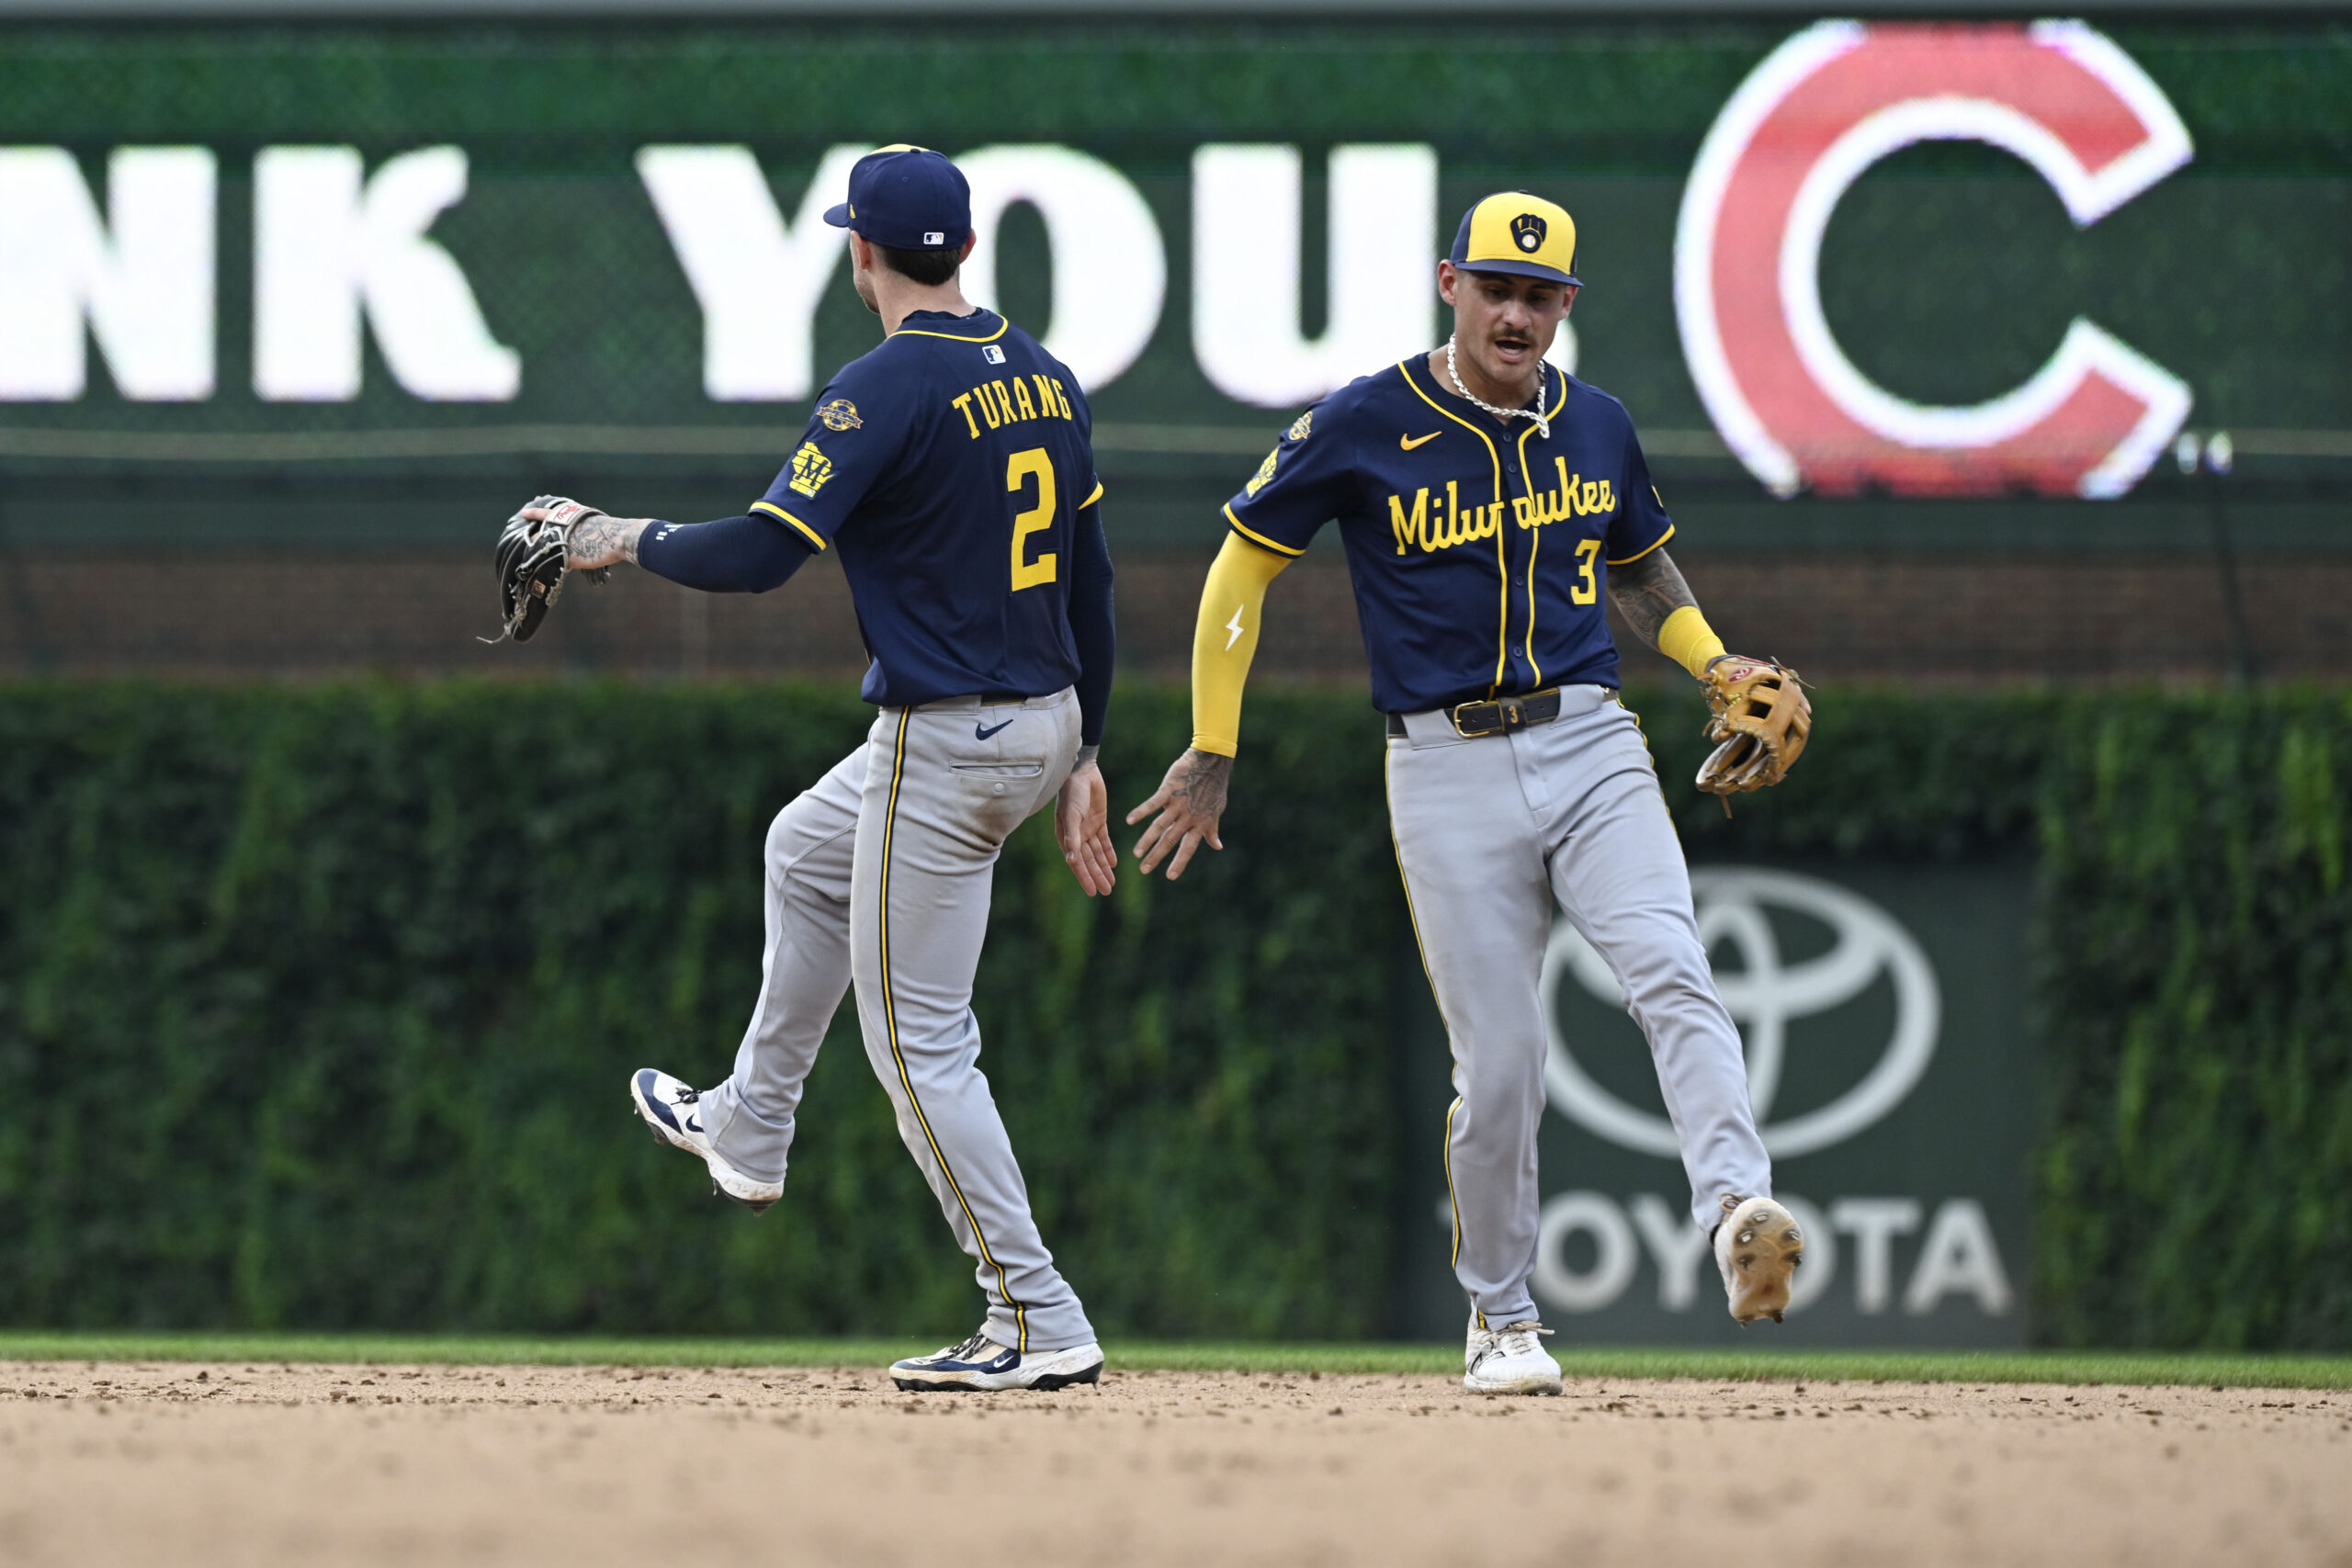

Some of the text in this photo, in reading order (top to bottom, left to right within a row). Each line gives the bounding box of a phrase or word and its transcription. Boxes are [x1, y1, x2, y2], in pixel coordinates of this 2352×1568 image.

[0, 144, 522, 402] NK
[952, 374, 1072, 440] TURANG
[1006, 446, 1057, 592] 2
[1388, 456, 1616, 556] Milwaukee
[1570, 538, 1602, 605] 3
[1508, 705, 1520, 724] 3
[1436, 1190, 2016, 1314] OYTA
